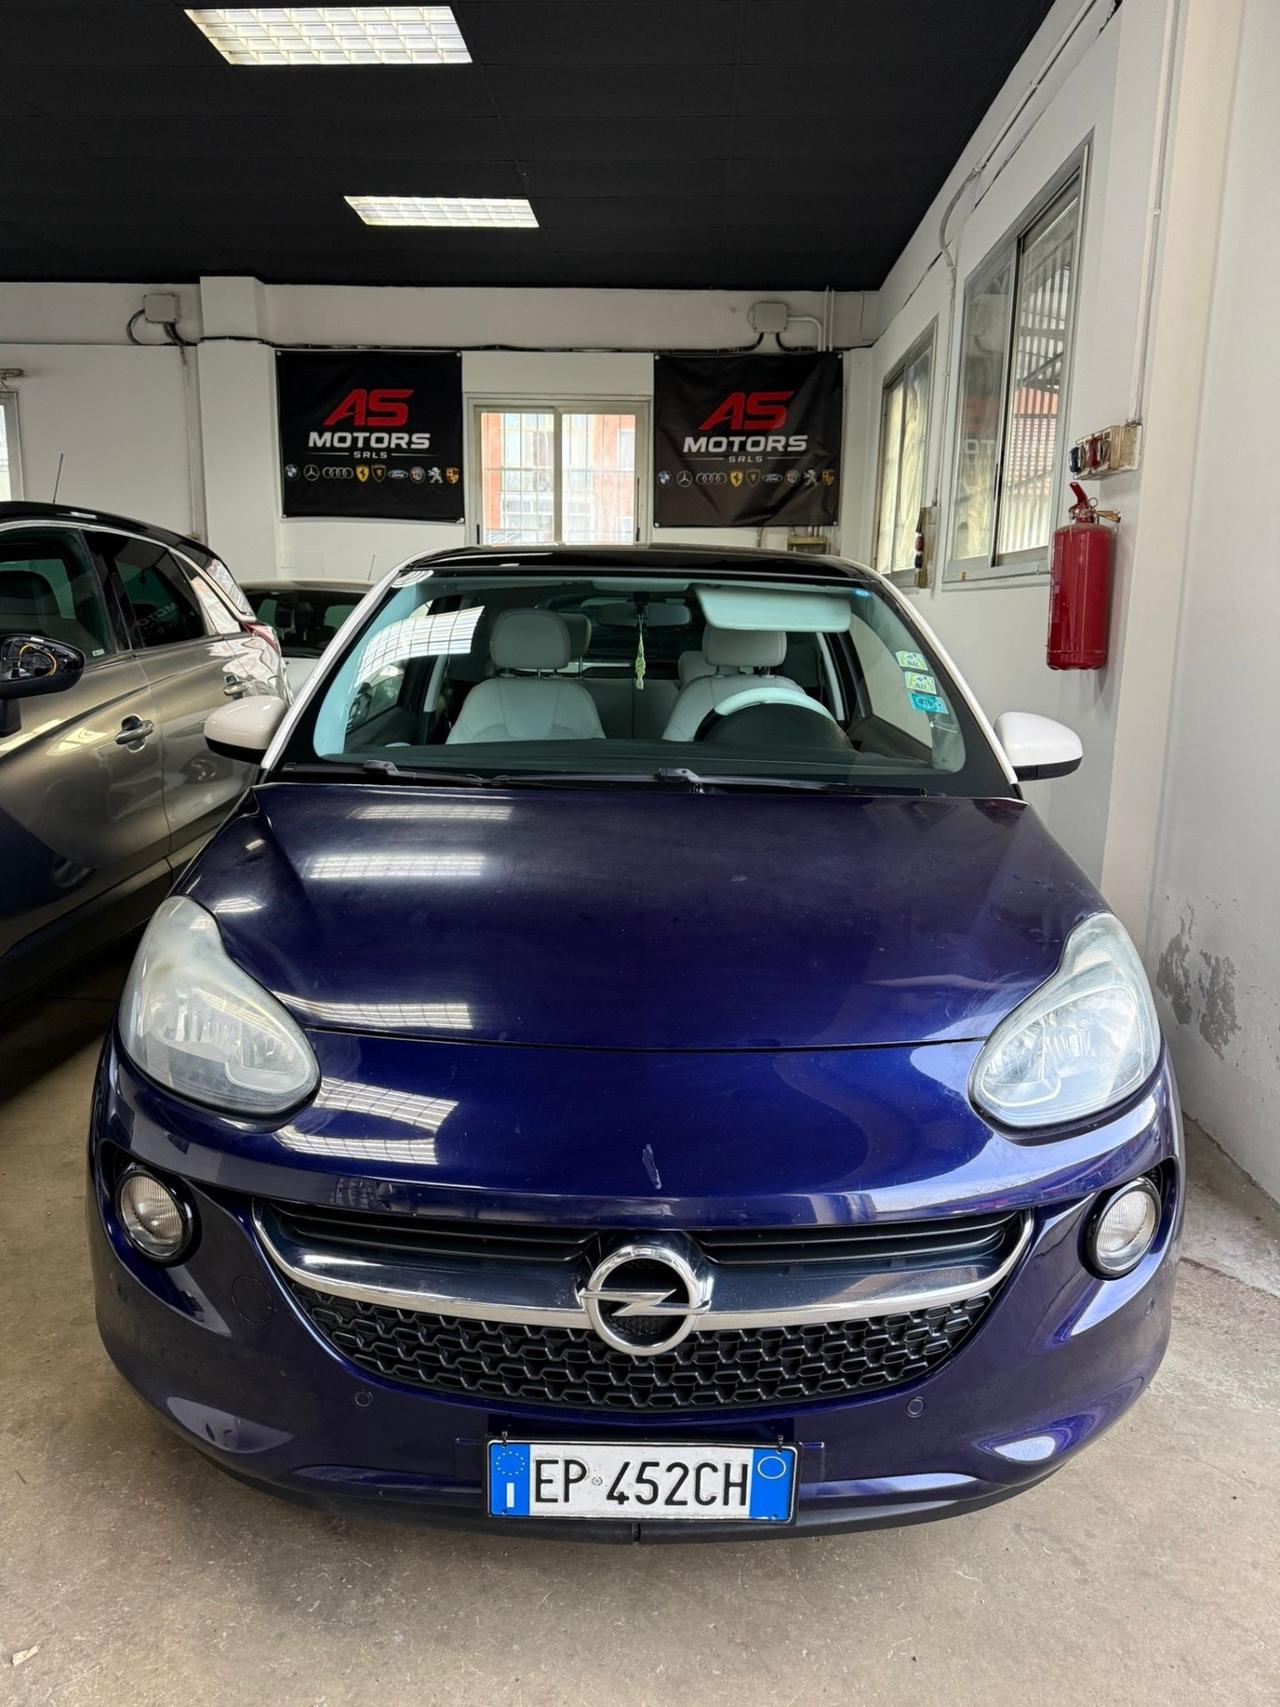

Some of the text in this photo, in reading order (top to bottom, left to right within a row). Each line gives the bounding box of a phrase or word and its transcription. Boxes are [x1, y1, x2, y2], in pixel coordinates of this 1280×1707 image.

[323, 388, 415, 426] AS
[698, 390, 794, 430] AS
[308, 431, 431, 449] MOTORS
[683, 435, 809, 453] MOTORS
[353, 451, 388, 459] SRLS
[728, 455, 763, 463] SRLS
[534, 1459, 749, 1506] EP 452CH
